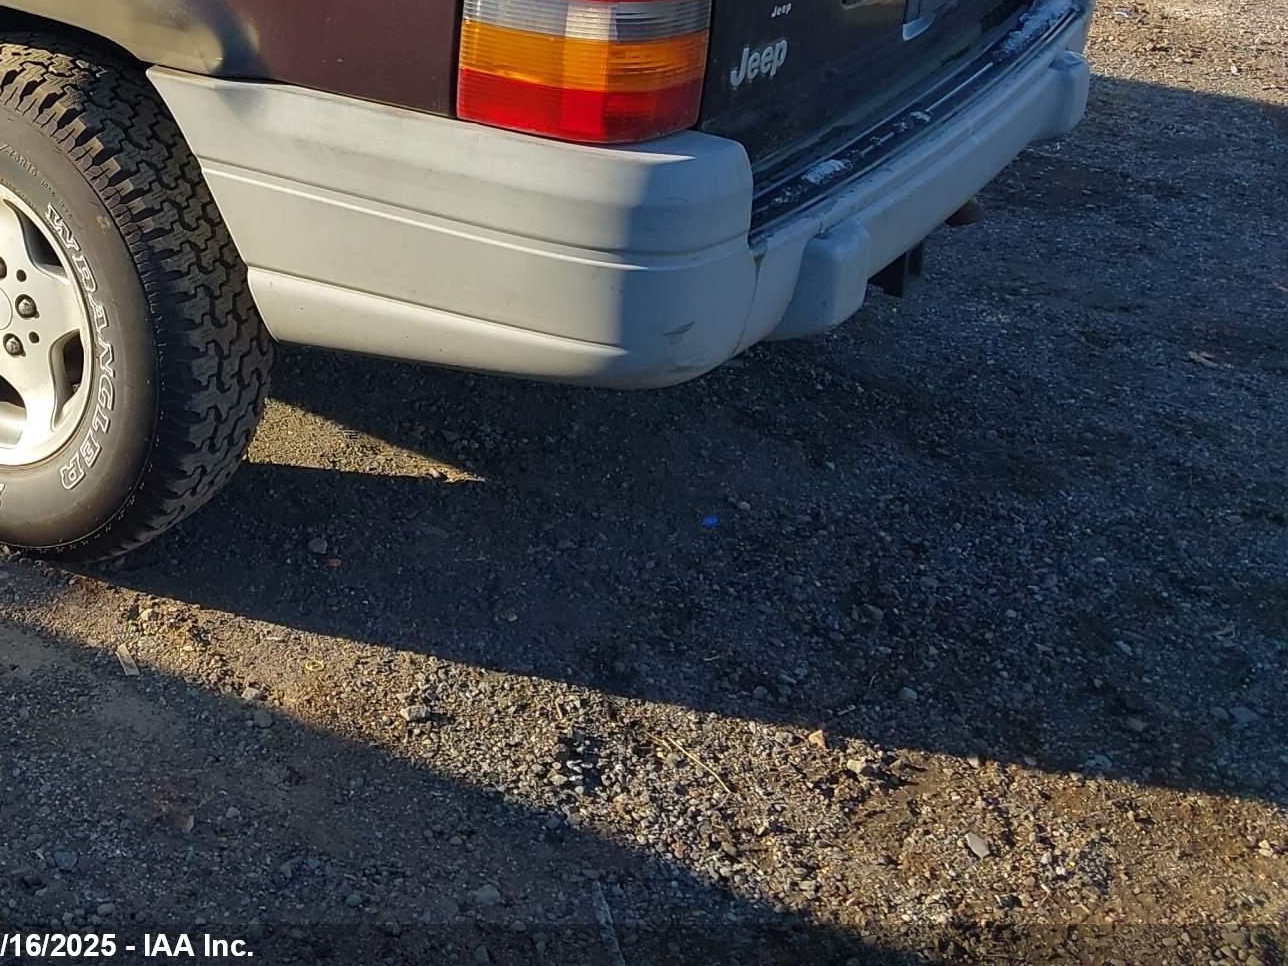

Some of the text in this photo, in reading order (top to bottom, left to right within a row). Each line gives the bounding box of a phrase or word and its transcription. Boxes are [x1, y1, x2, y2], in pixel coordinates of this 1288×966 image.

[771, 2, 792, 19] Jeep
[730, 39, 788, 87] Jeep
[45, 203, 118, 490] WRANGLER
